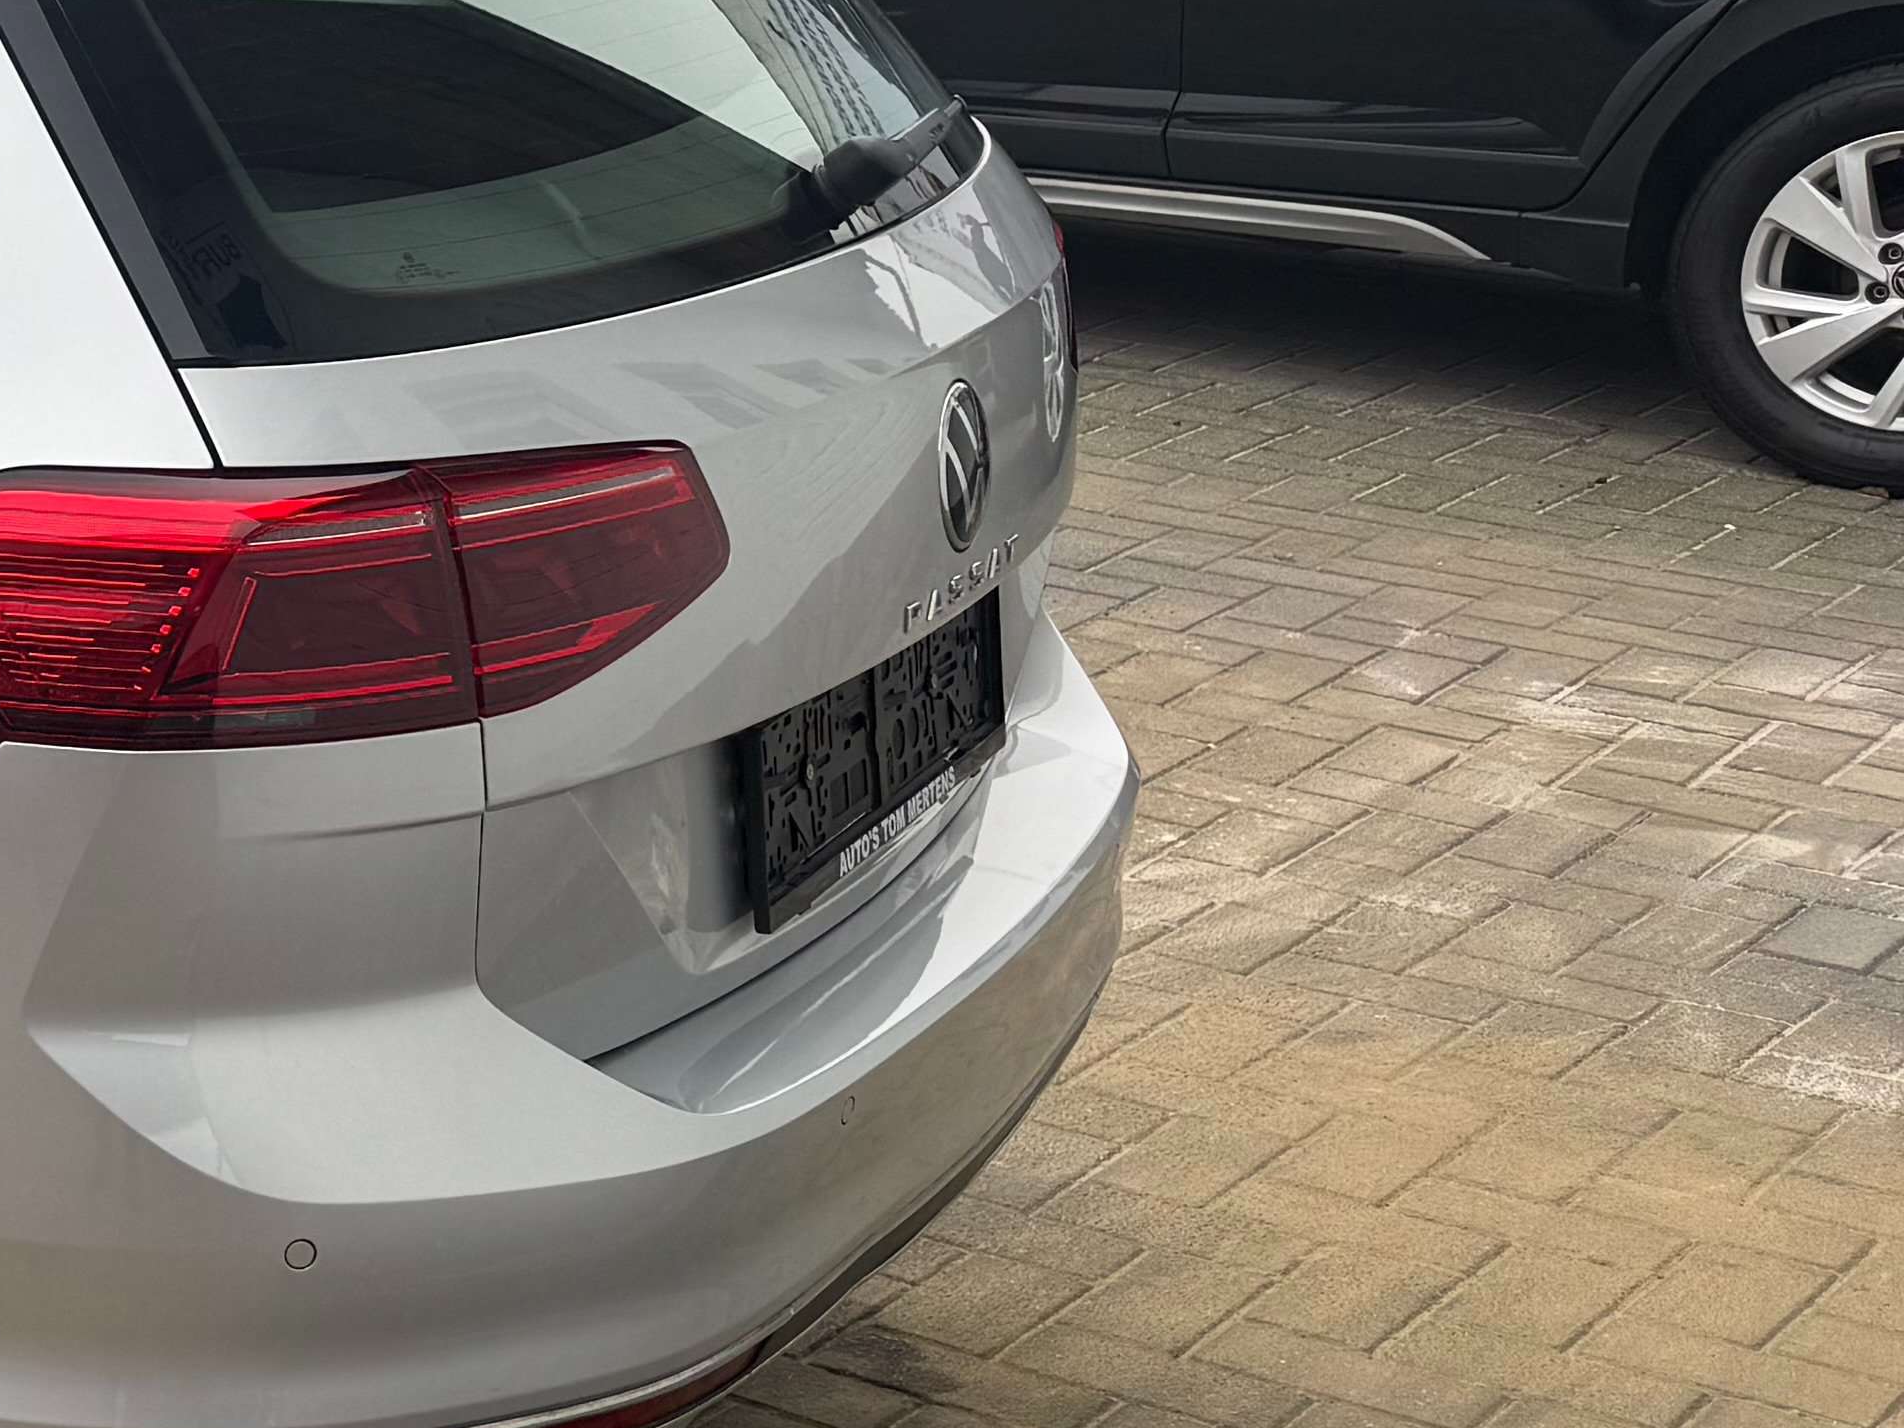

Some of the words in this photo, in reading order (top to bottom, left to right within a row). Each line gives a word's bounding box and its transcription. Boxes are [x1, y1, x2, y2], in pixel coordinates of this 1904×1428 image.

[903, 533, 1019, 634] PASSAT
[839, 825, 880, 877] AUTO'S
[881, 805, 906, 842] TOM
[907, 765, 957, 823] MERTENS
